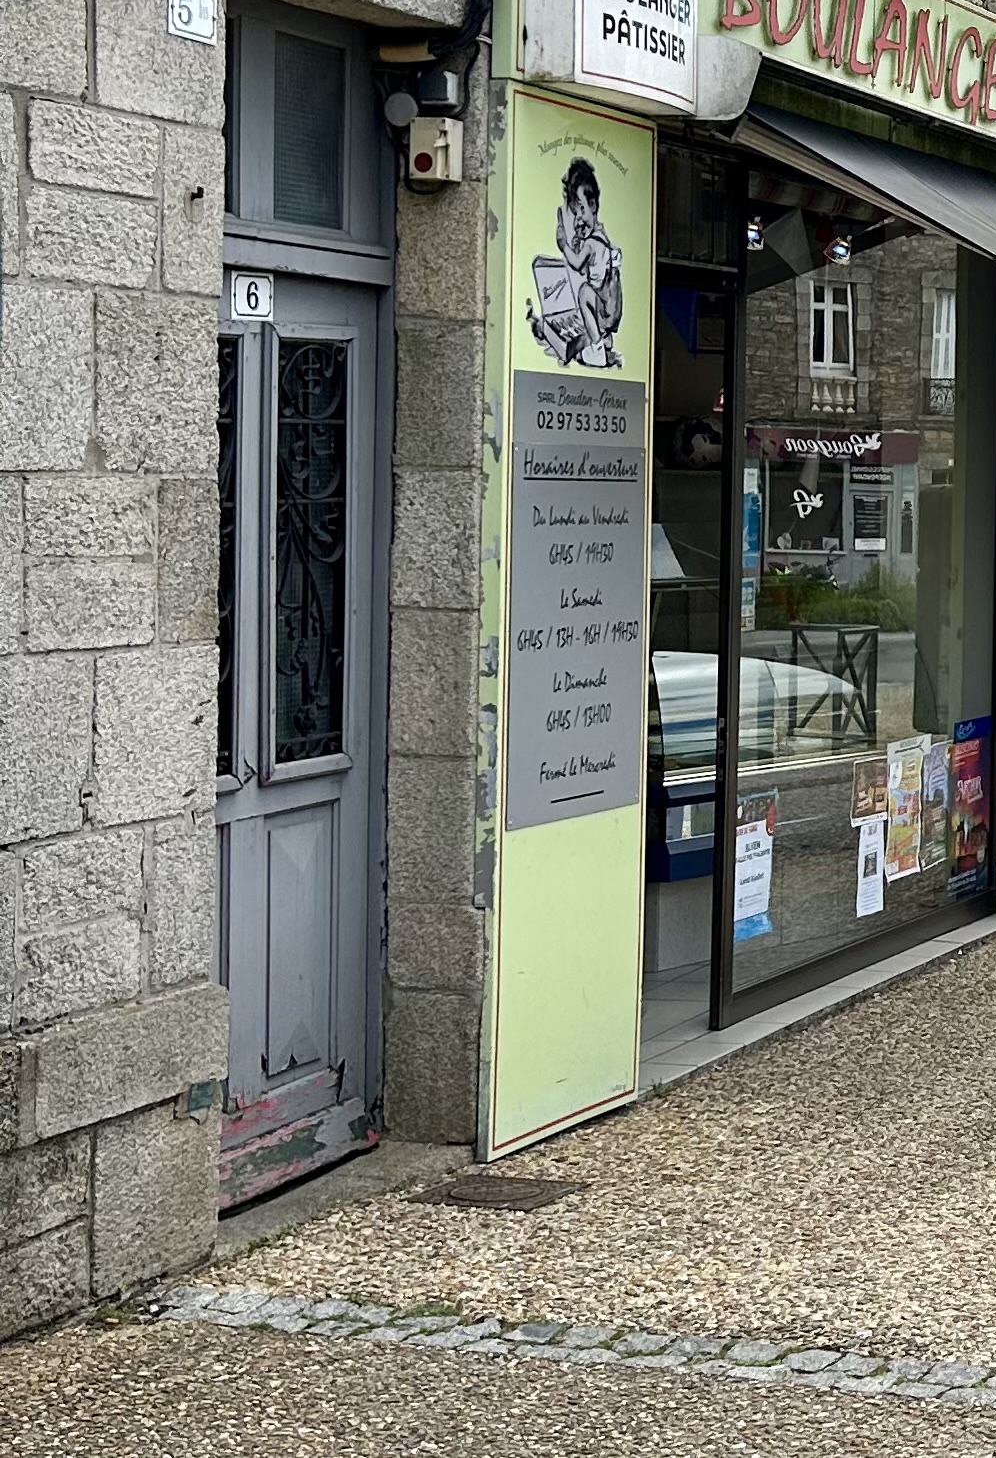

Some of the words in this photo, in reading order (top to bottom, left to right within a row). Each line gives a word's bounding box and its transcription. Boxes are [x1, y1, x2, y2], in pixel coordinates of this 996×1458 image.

[602, 9, 686, 67] PÂTISSIER
[245, 280, 260, 311] 6
[536, 410, 554, 430] 02
[557, 411, 573, 431] 97
[575, 413, 591, 432] 53
[593, 414, 608, 433] 33
[611, 415, 627, 434] 50
[524, 448, 578, 477] Horaires
[533, 505, 546, 527] Du
[549, 505, 576, 526] Lundi
[592, 504, 629, 526] Vendredi
[548, 543, 574, 566] 6H45
[571, 587, 603, 609] Samedi
[516, 628, 544, 652] 6H45
[565, 667, 608, 692] Dimanche
[546, 710, 571, 732] 6H45
